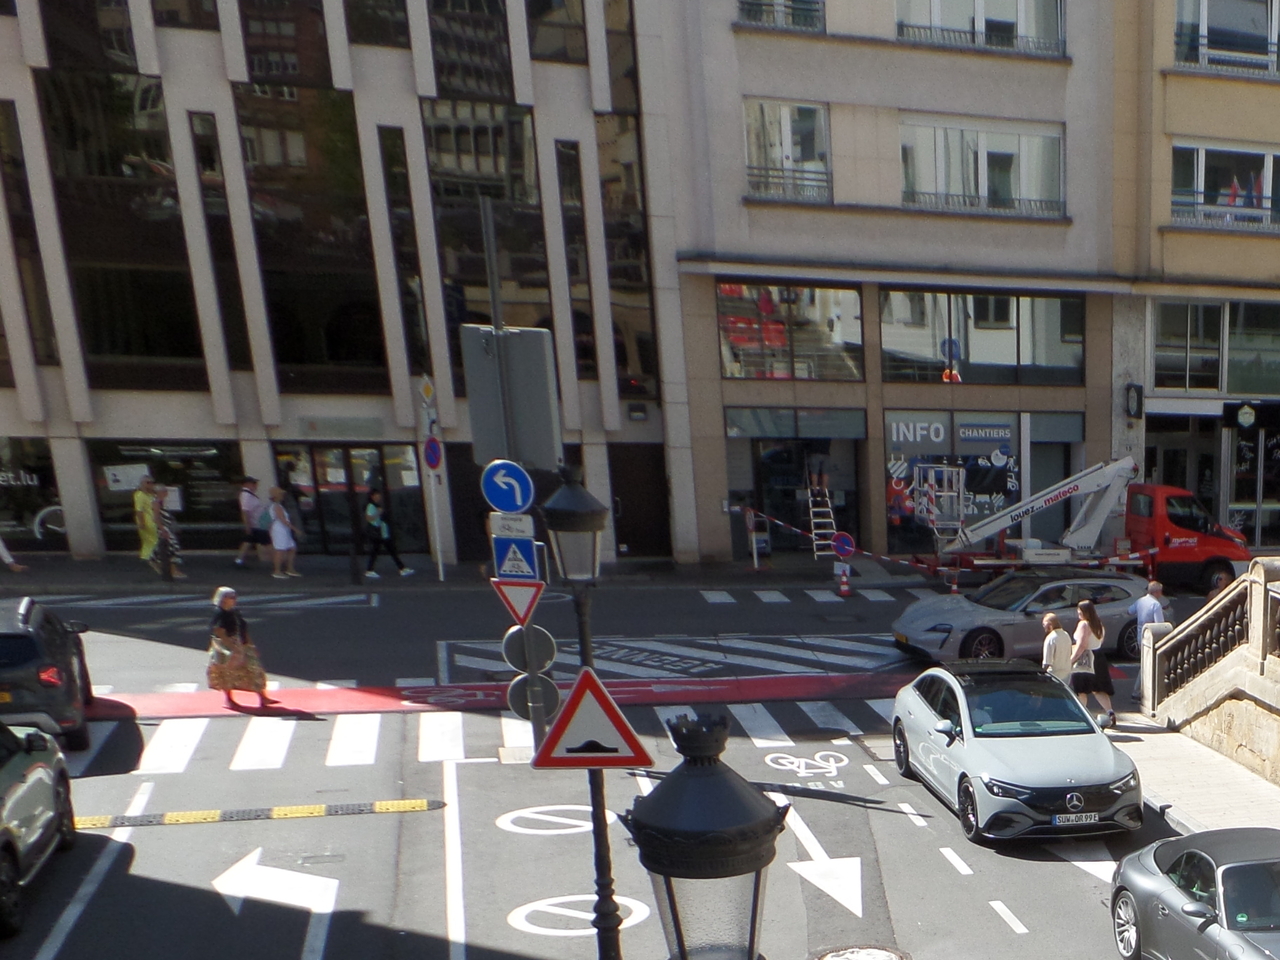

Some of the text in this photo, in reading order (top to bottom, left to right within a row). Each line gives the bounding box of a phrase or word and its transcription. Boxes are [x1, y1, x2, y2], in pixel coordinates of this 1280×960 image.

[891, 422, 945, 443] INFO
[959, 428, 1011, 438] CHANTIERS
[1043, 484, 1079, 507] mateco
